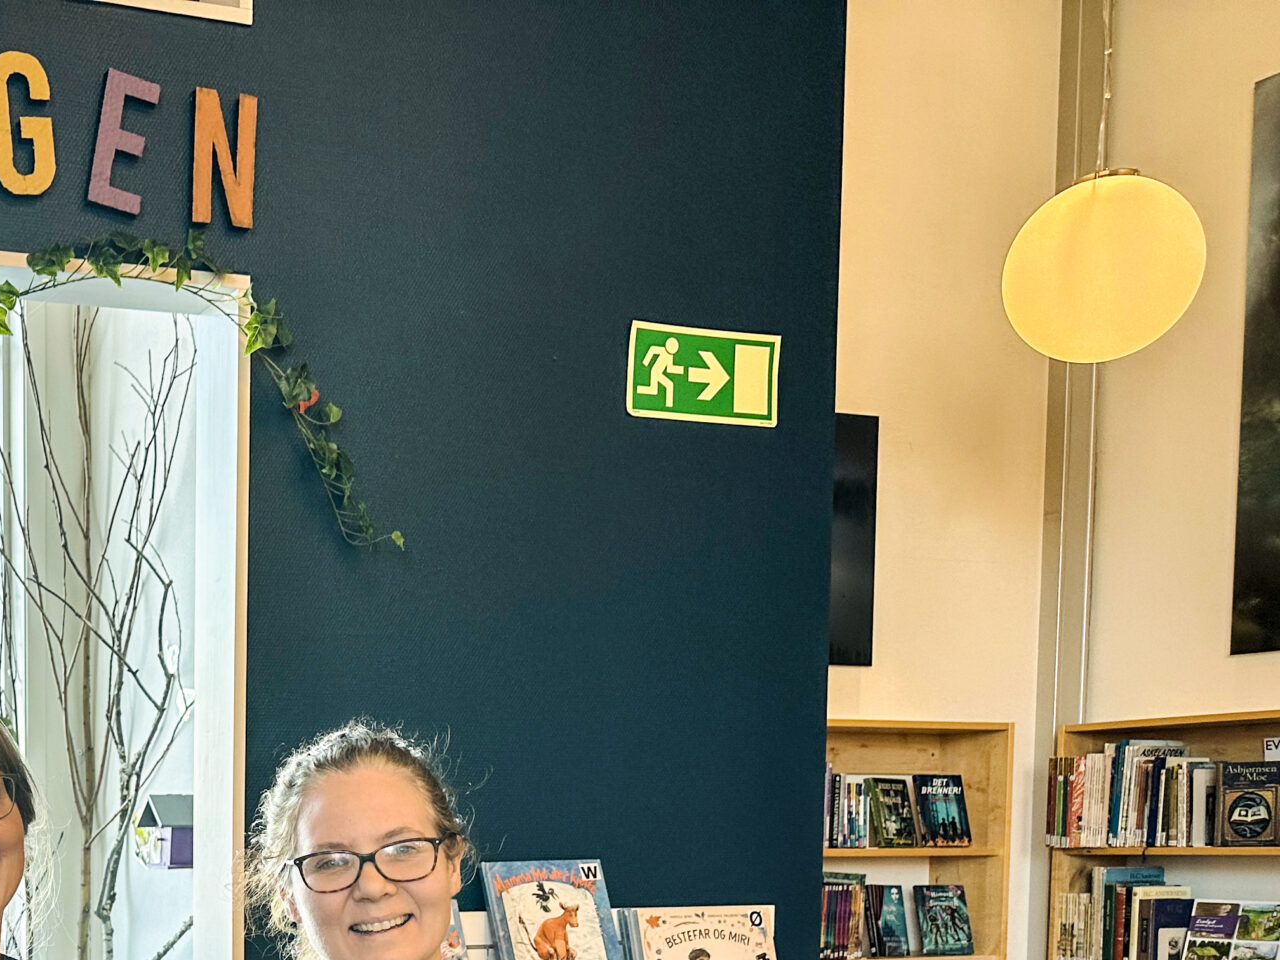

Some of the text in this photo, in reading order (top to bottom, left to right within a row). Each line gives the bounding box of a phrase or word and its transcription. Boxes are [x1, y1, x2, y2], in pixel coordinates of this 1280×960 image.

[581, 866, 598, 880] W
[749, 910, 763, 927] Ø
[664, 928, 750, 949] BESTEFAR OG MIRI
